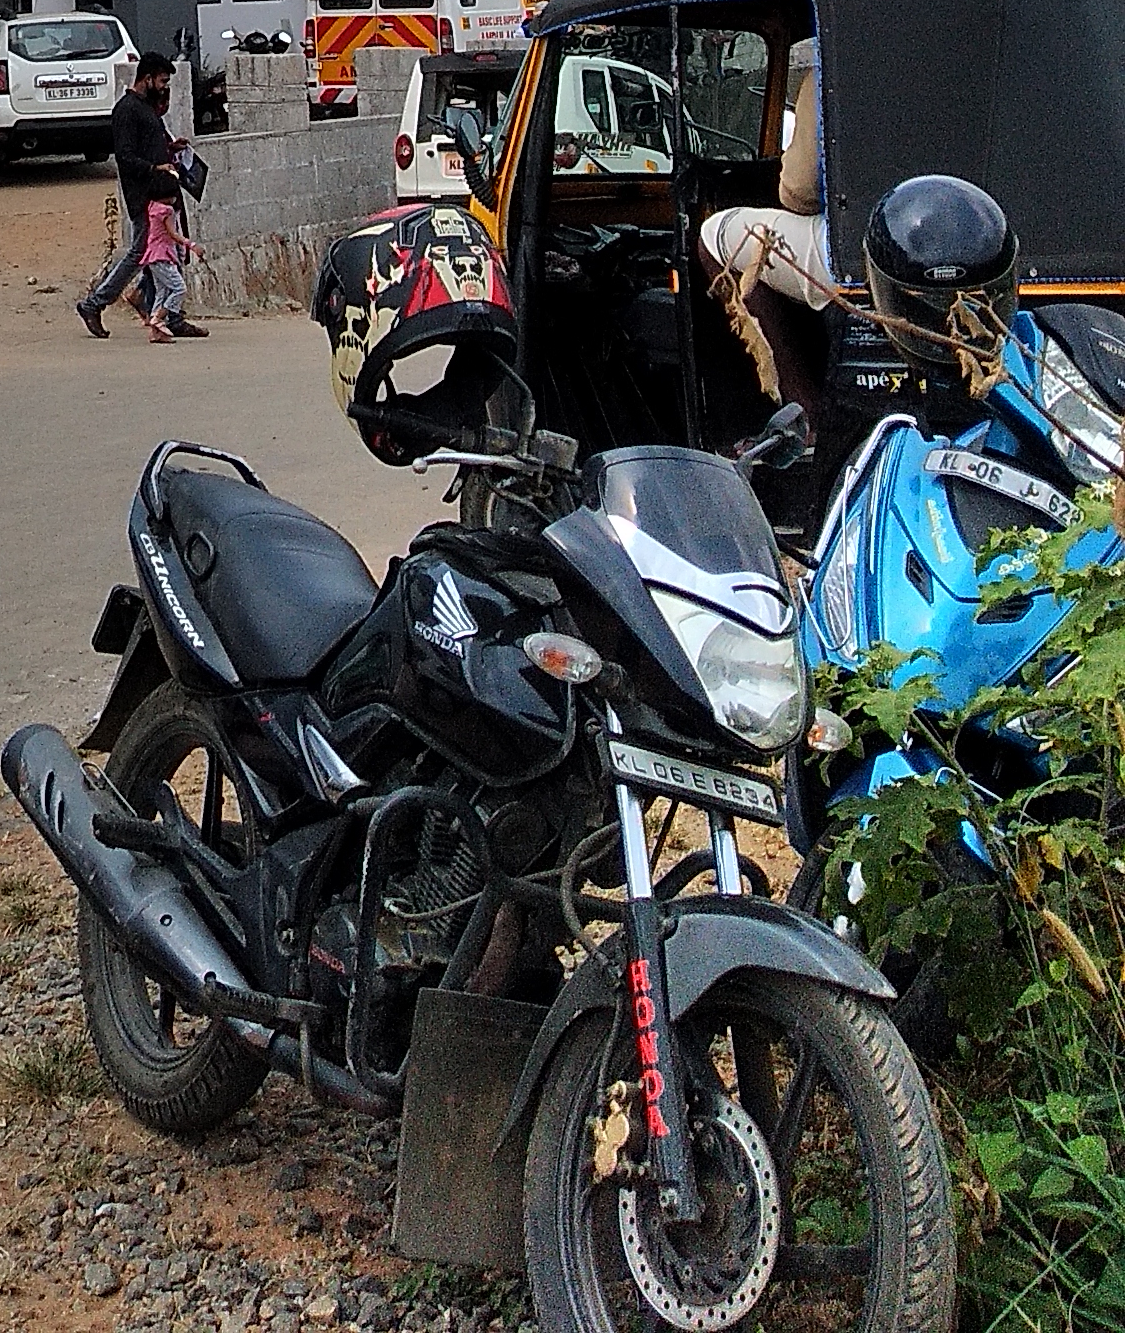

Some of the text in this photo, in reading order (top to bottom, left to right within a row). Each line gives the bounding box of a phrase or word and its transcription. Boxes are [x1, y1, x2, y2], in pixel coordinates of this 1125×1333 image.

[478, 17, 493, 27] BASIC
[493, 16, 503, 26] LIFE
[47, 90, 57, 98] KL
[938, 452, 959, 470] KL
[975, 461, 1003, 484] 06
[414, 620, 464, 659] HONDA
[613, 750, 776, 811] KL 06 E 8234
[629, 958, 671, 1138] HONDA
